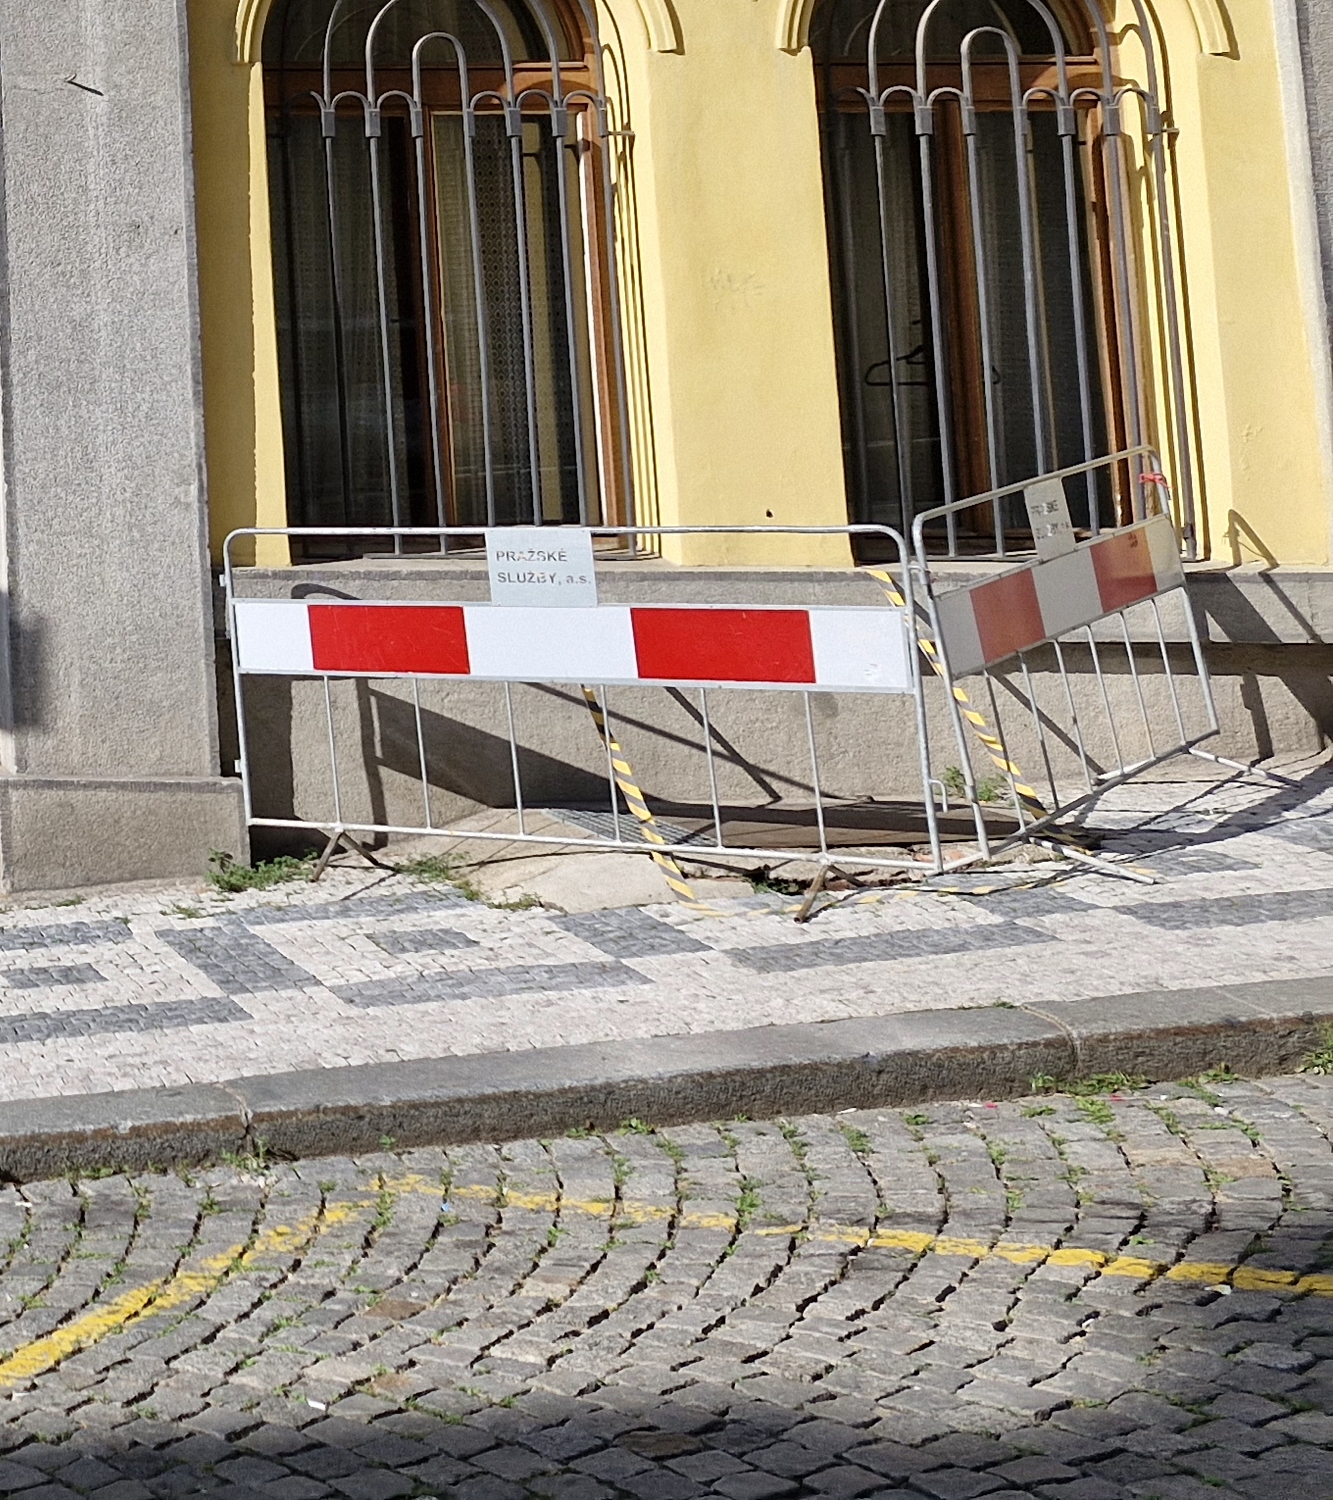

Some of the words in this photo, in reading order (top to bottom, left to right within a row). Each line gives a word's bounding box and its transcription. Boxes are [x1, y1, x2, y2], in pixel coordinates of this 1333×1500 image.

[496, 548, 567, 562] PRAŽSKÉ
[497, 570, 561, 585] SLUŽBY,
[566, 575, 592, 584] a.s.
